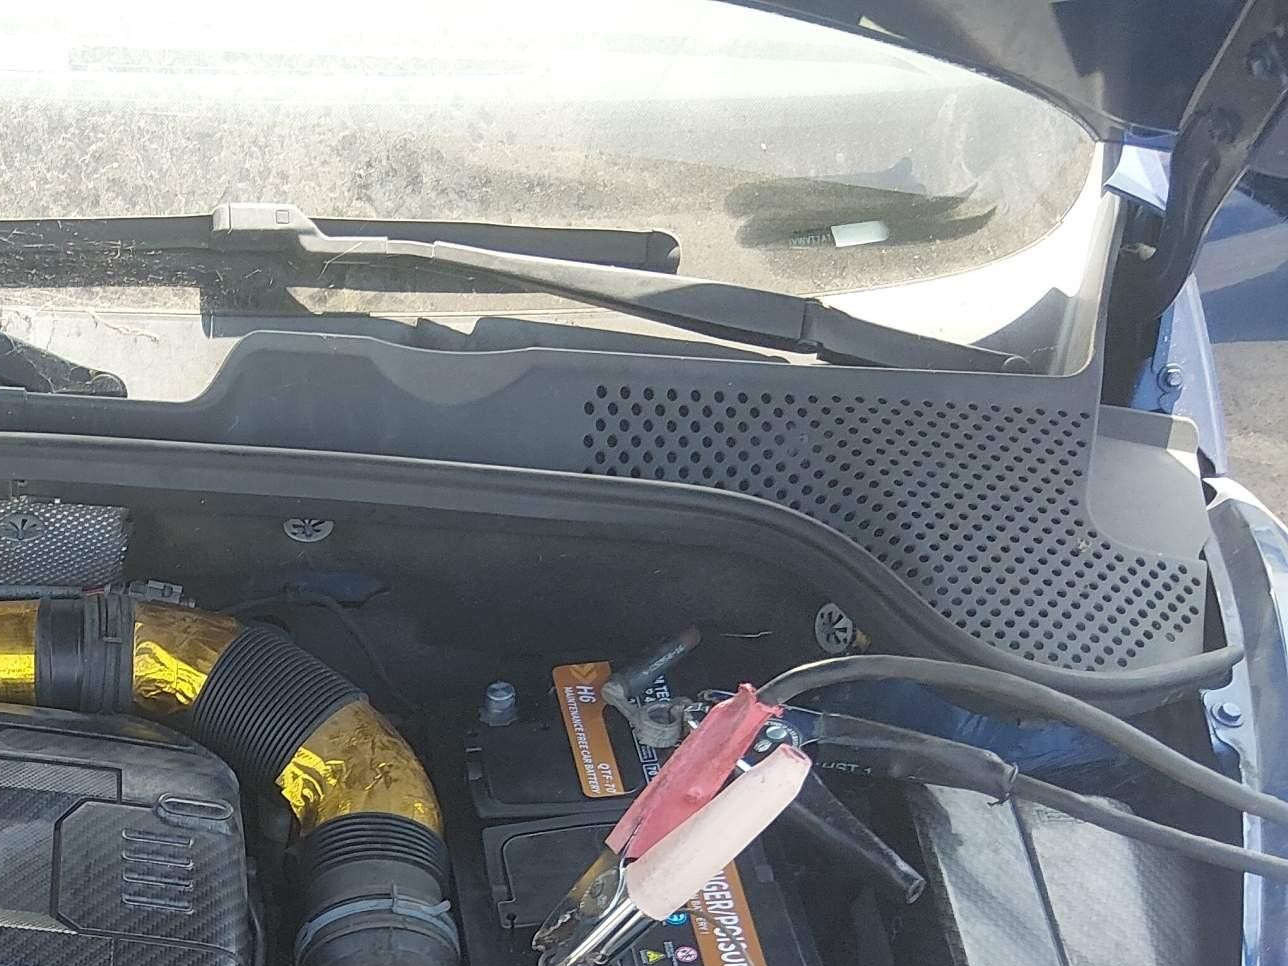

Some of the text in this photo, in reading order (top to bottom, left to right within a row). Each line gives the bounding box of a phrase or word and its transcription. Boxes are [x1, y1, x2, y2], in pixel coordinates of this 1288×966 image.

[575, 685, 597, 703] H6
[564, 686, 601, 794] MAINTENANCE FREE CAR BATTERY
[597, 762, 616, 793] QTF-70
